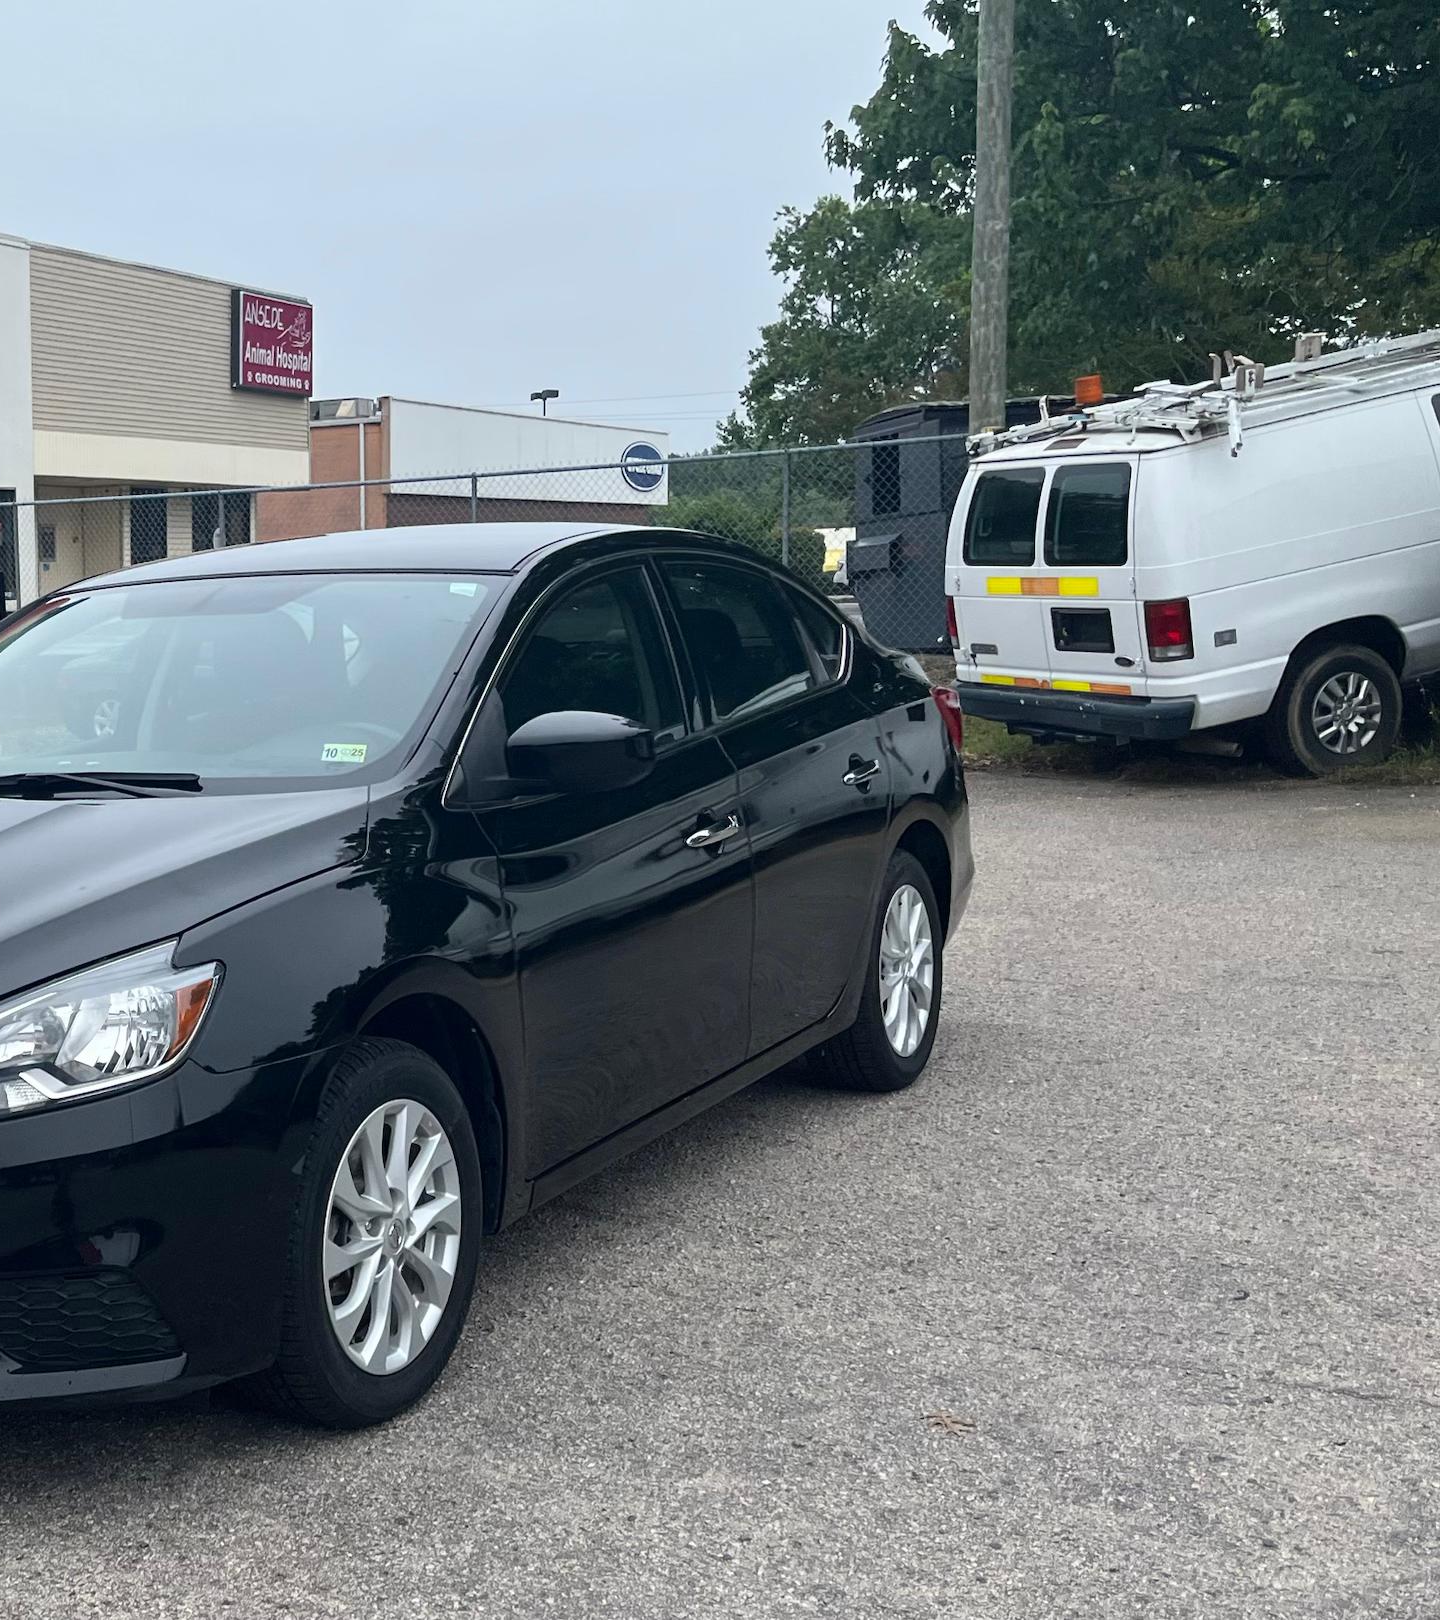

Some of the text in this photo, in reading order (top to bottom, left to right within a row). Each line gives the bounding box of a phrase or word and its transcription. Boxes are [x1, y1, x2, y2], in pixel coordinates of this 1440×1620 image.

[245, 300, 284, 330] ANSEDE
[245, 341, 311, 375] Animal Hospital
[255, 372, 302, 389] GROOMING
[325, 748, 364, 758] 10 25
